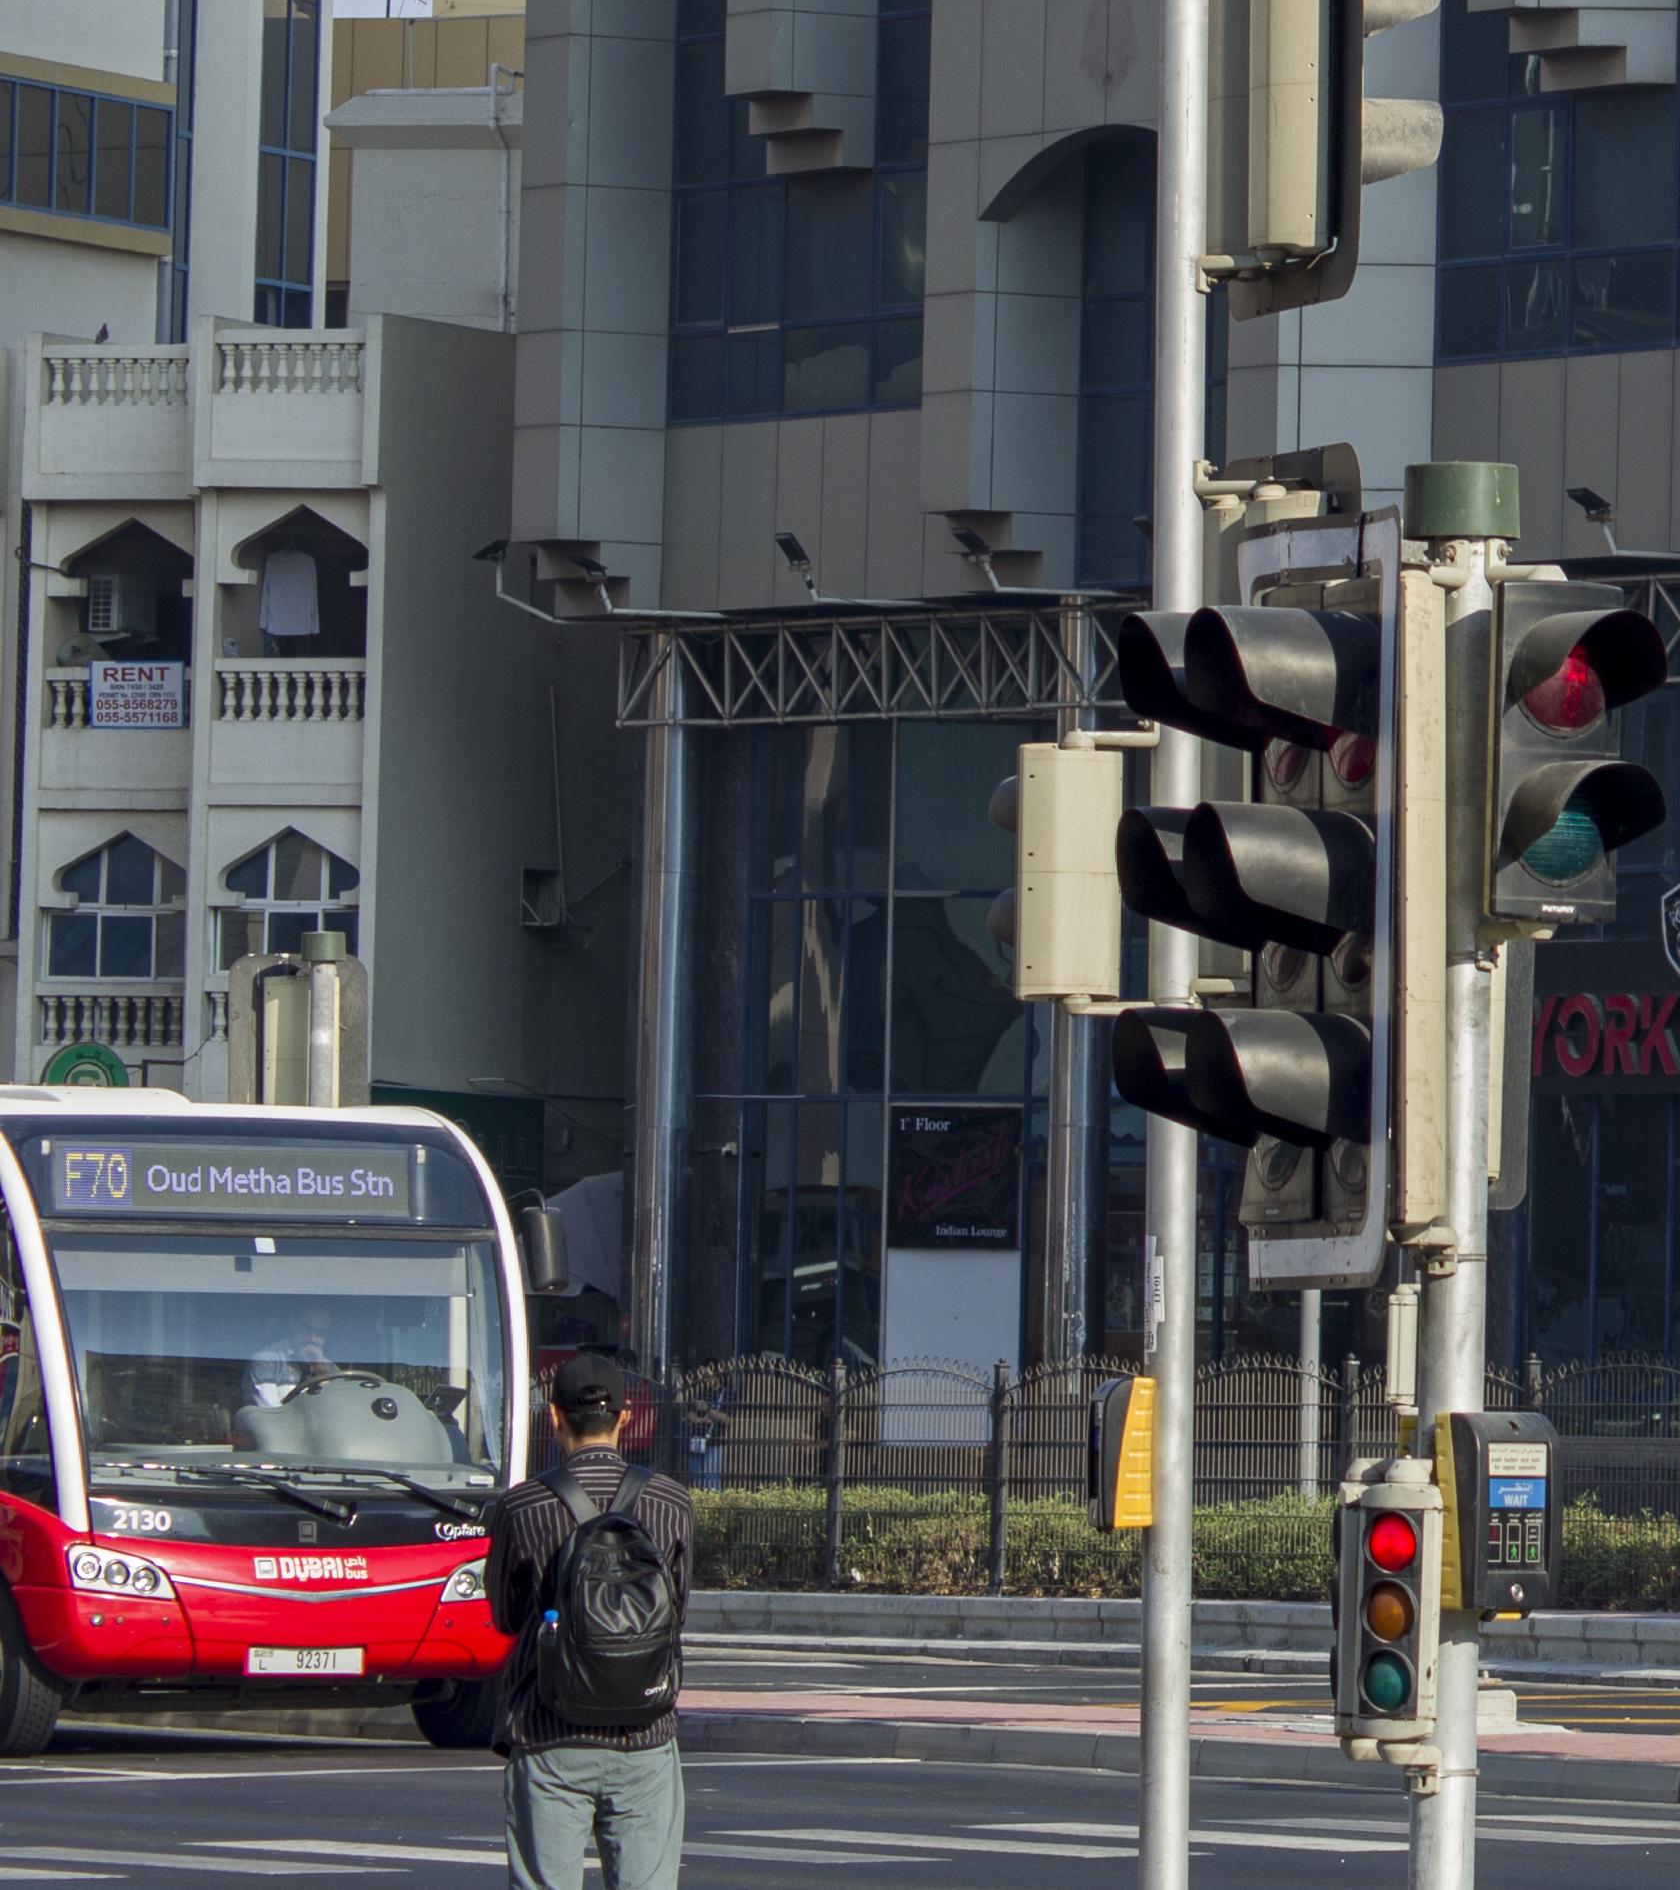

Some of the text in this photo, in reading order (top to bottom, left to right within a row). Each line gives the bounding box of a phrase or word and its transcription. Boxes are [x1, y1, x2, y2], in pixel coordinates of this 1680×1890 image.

[103, 667, 170, 682] RENT
[96, 699, 178, 710] 055-8568279
[96, 712, 178, 723] 055-5571168
[915, 1116, 950, 1131] Floor
[64, 1152, 395, 1200] F70 Oud Metha Bus Stn
[935, 1225, 1008, 1239] Indian Lounge
[1504, 1494, 1529, 1507] WAIT
[113, 1509, 172, 1532] 2130
[345, 1567, 368, 1580] bus
[296, 1651, 337, 1669] 92371
